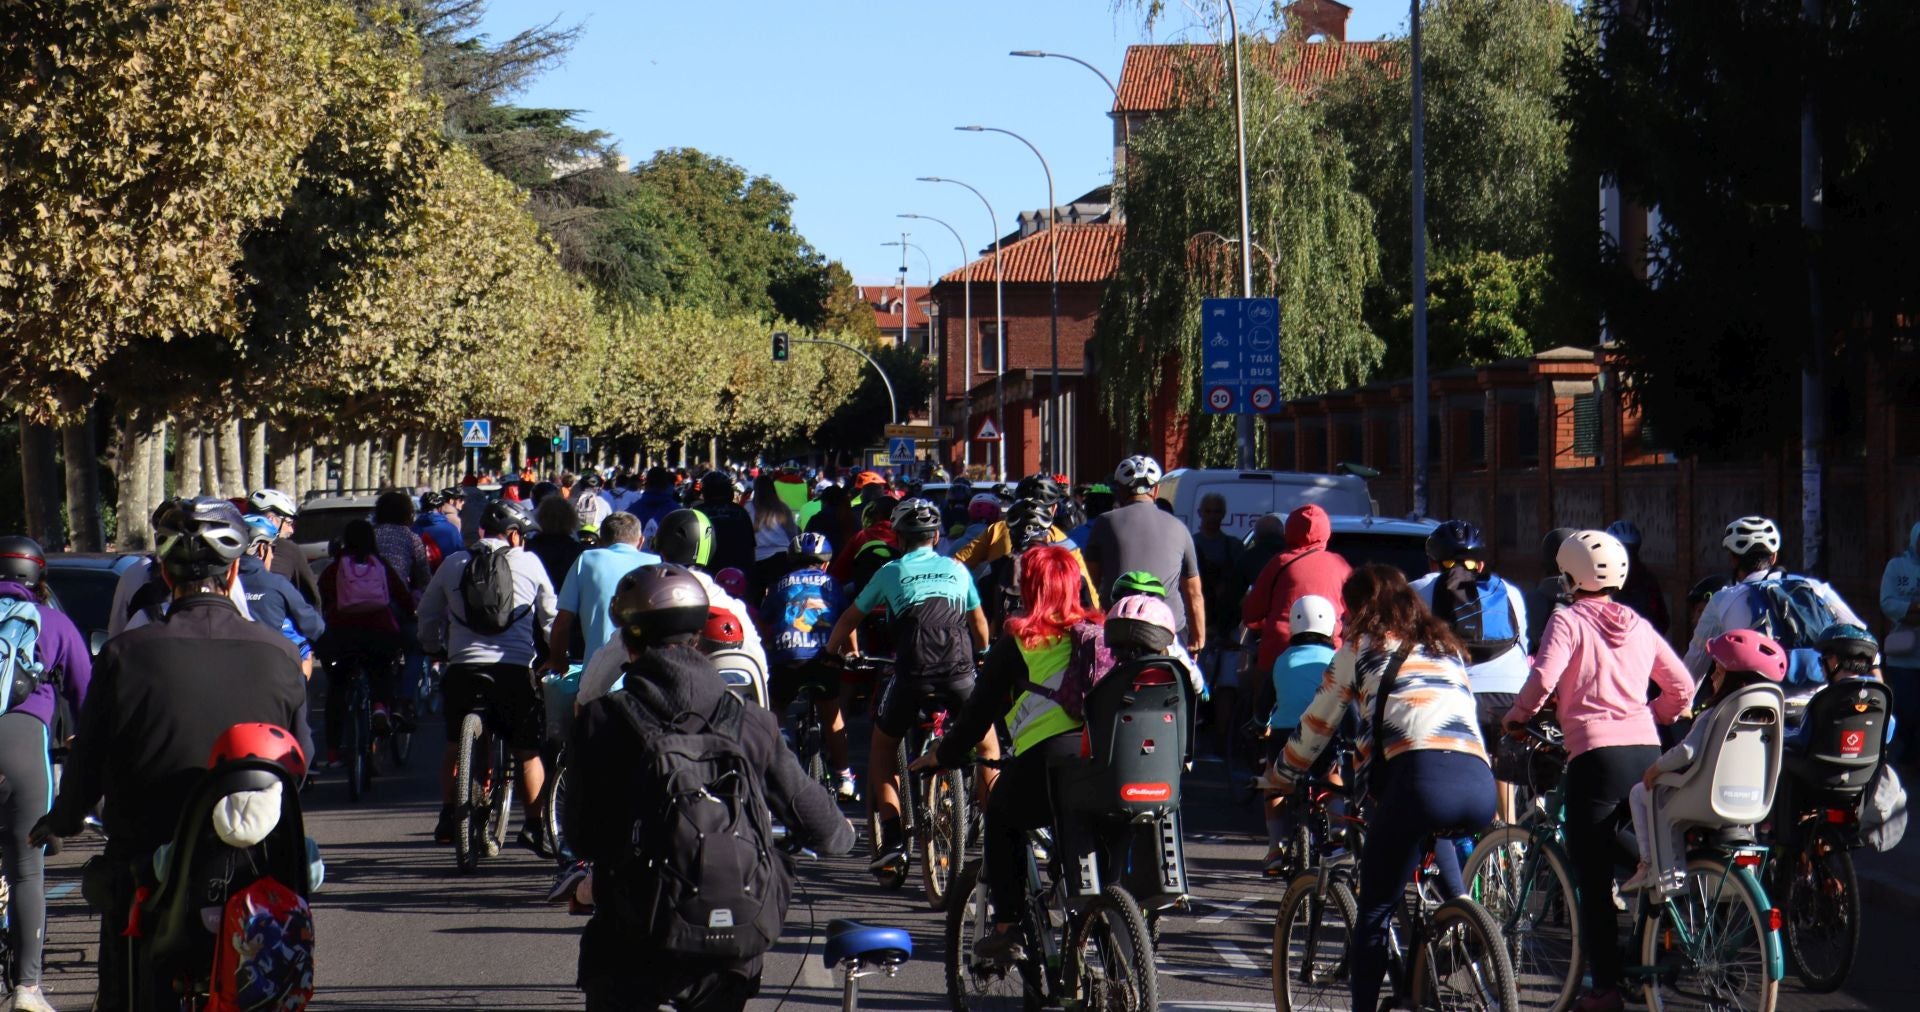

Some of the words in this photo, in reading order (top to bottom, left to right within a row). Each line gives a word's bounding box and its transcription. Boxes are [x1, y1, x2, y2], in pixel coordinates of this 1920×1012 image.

[1250, 354, 1273, 364] TAXI
[1250, 367, 1273, 377] BUS
[1213, 394, 1228, 403] 30
[900, 573, 958, 584] ORBEA
